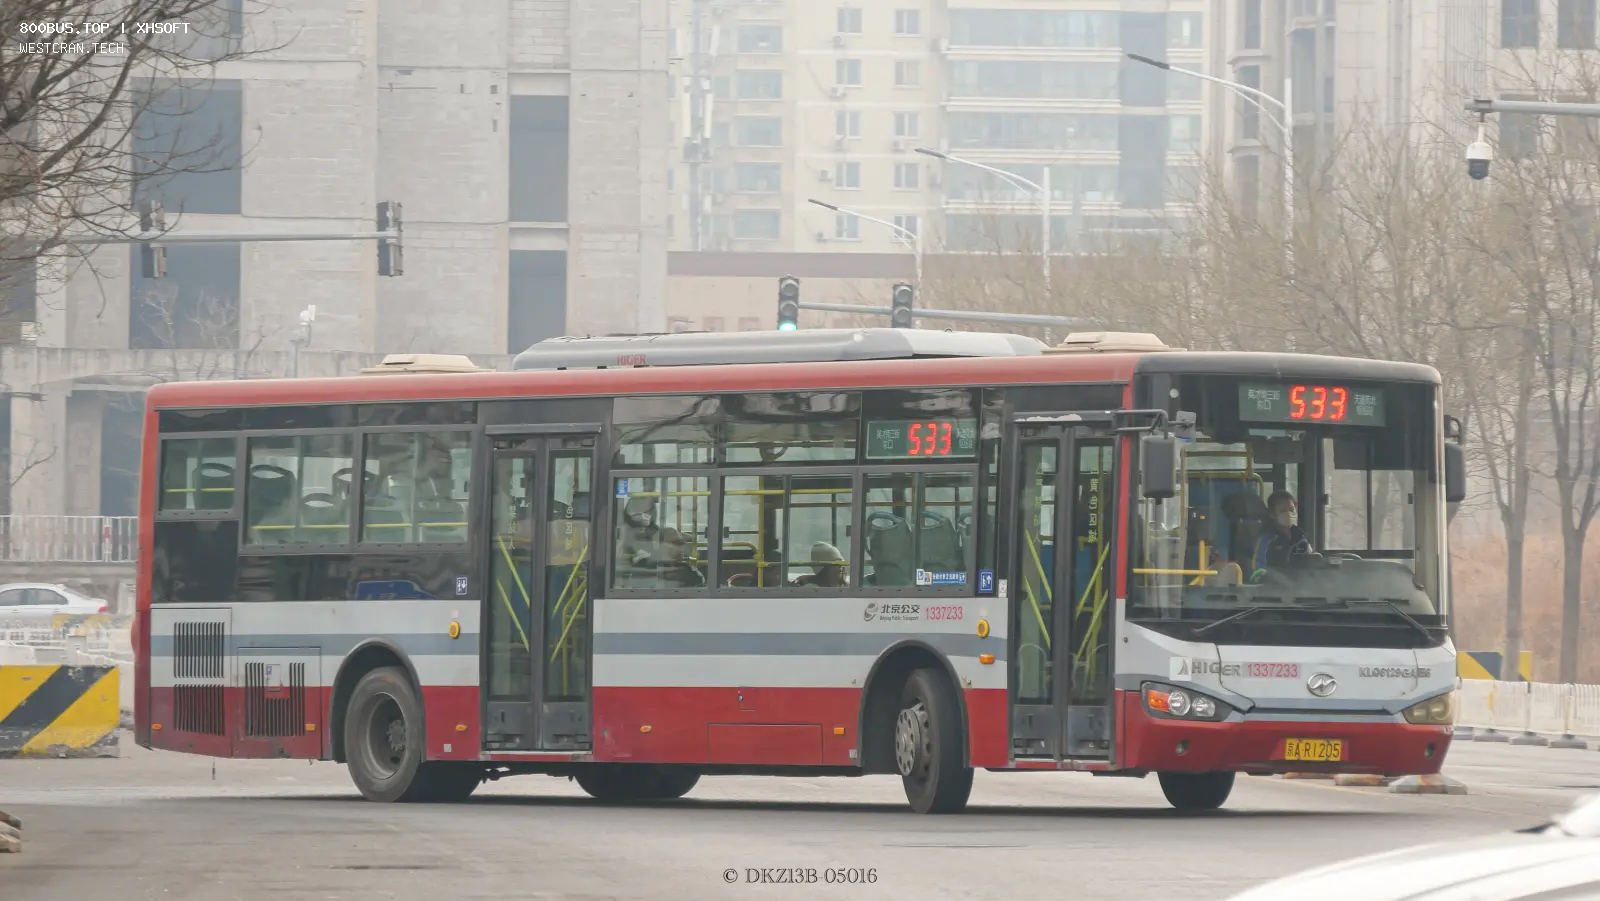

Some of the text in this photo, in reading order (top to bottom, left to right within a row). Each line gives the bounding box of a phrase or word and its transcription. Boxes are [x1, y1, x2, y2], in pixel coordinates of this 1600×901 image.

[1289, 385, 1348, 421] 533
[907, 422, 953, 456] 533
[880, 604, 921, 614] 北京公交
[925, 606, 963, 620] 1337233
[1191, 661, 1241, 676] HIGER
[1247, 663, 1298, 678] 1337233
